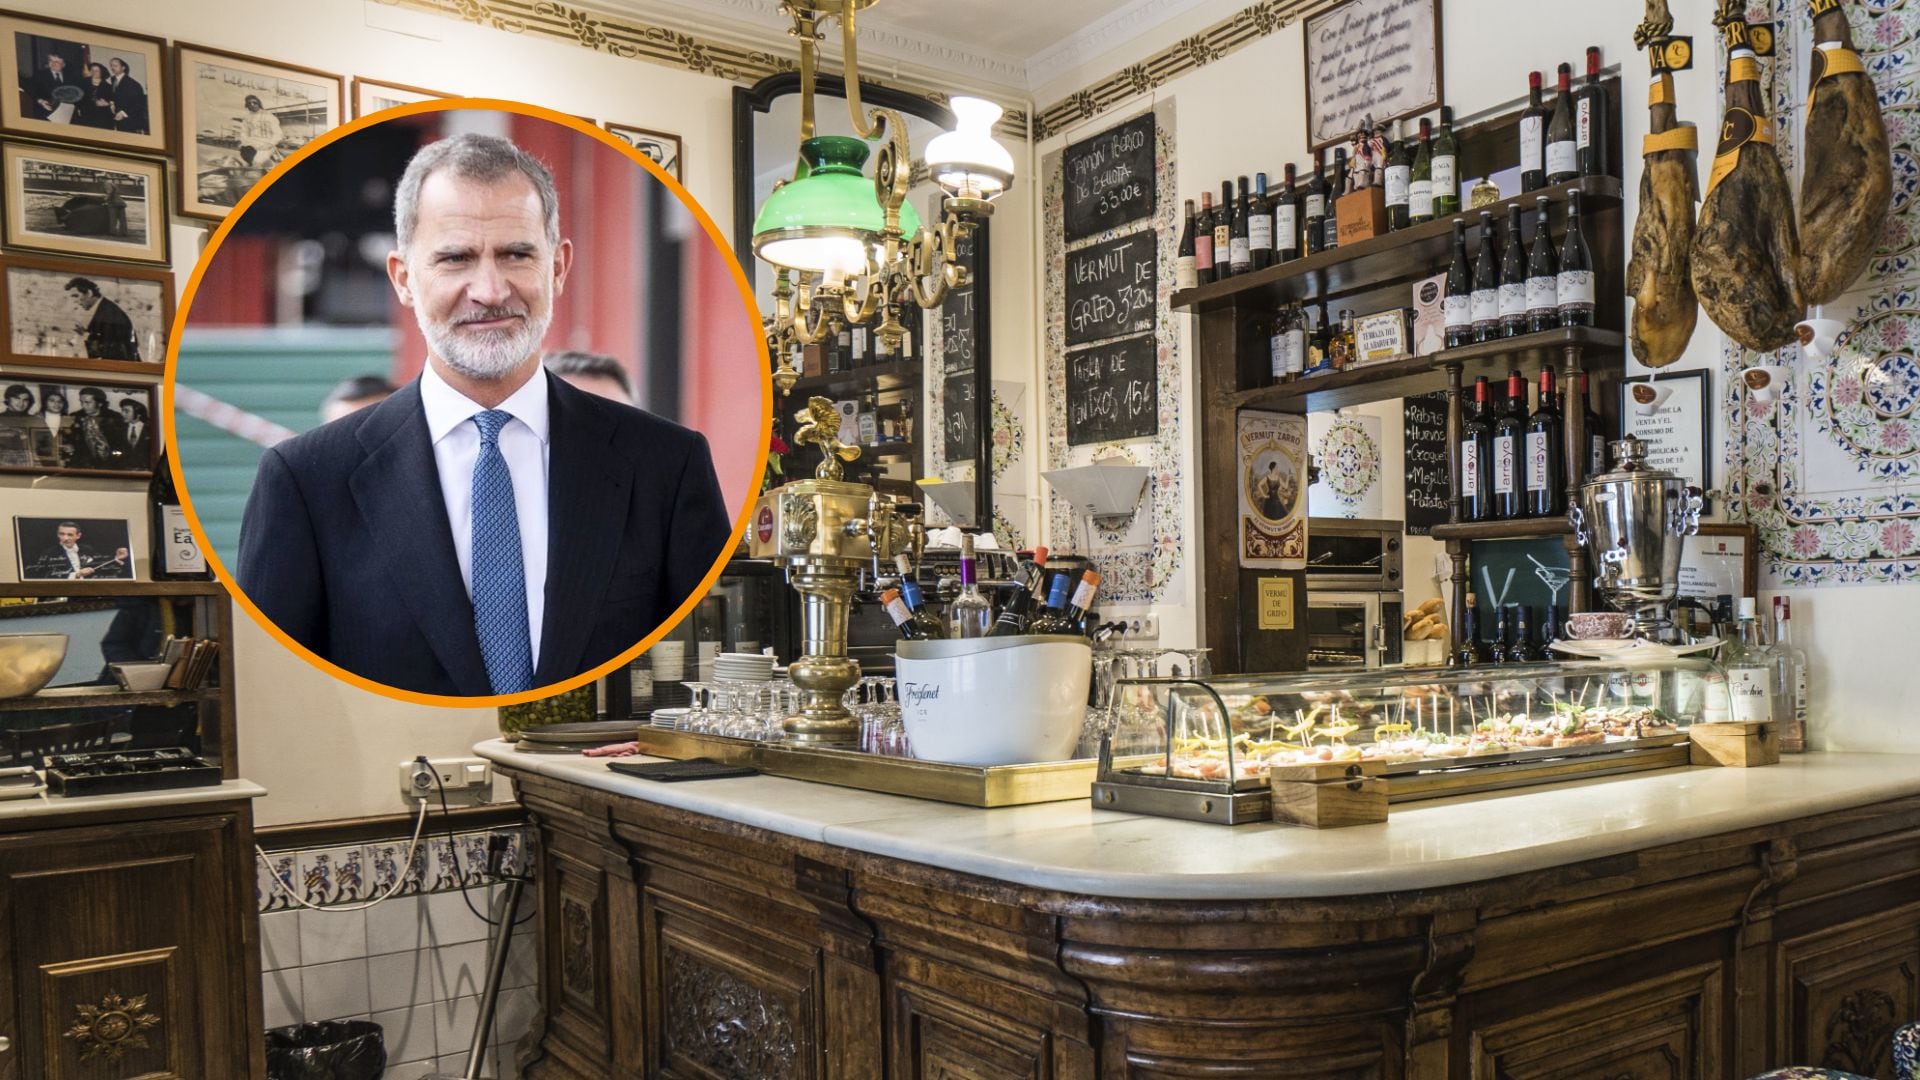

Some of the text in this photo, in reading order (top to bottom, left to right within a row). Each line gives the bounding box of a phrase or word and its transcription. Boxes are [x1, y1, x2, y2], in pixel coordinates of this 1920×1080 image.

[1075, 184, 1090, 204] DE
[1073, 242, 1152, 285] VERMUT DE
[1070, 294, 1116, 333] GRIFO
[1111, 350, 1128, 372] DE
[1244, 431, 1301, 446] VERMUT ZARRO
[1411, 426, 1446, 441] Huevos
[1635, 428, 1664, 436] CONSUMO
[1410, 443, 1449, 464] Croquet
[1502, 440, 1513, 486] arroyo
[1536, 436, 1547, 483] arroyo
[1467, 444, 1477, 489] arroyo
[1411, 488, 1449, 510] Patatas
